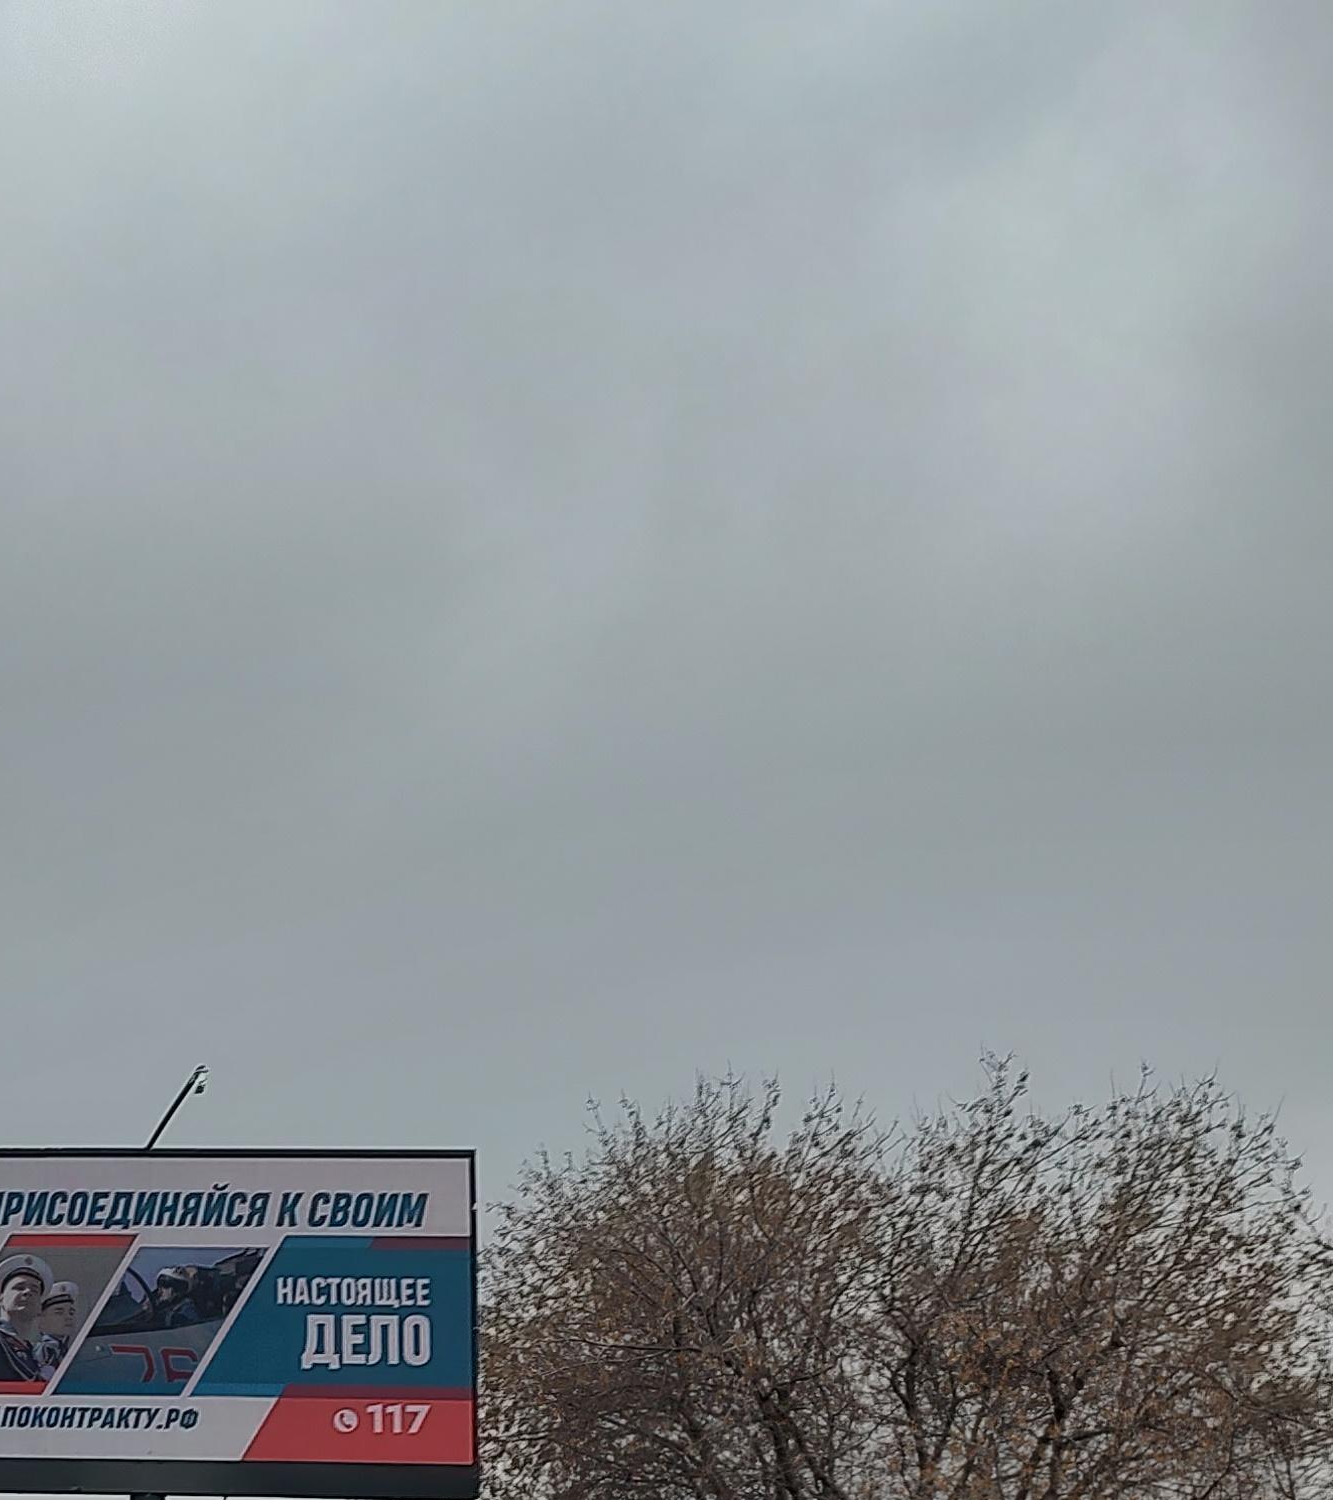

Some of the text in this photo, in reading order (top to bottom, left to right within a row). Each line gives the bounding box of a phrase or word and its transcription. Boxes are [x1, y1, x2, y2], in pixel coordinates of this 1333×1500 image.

[275, 1192, 301, 1228] К
[309, 1192, 429, 1228] СВОИМ
[276, 1277, 432, 1307] НАСТОЯЩЕЕ
[301, 1313, 433, 1370] ДЕЛО
[366, 1403, 432, 1436] 117
